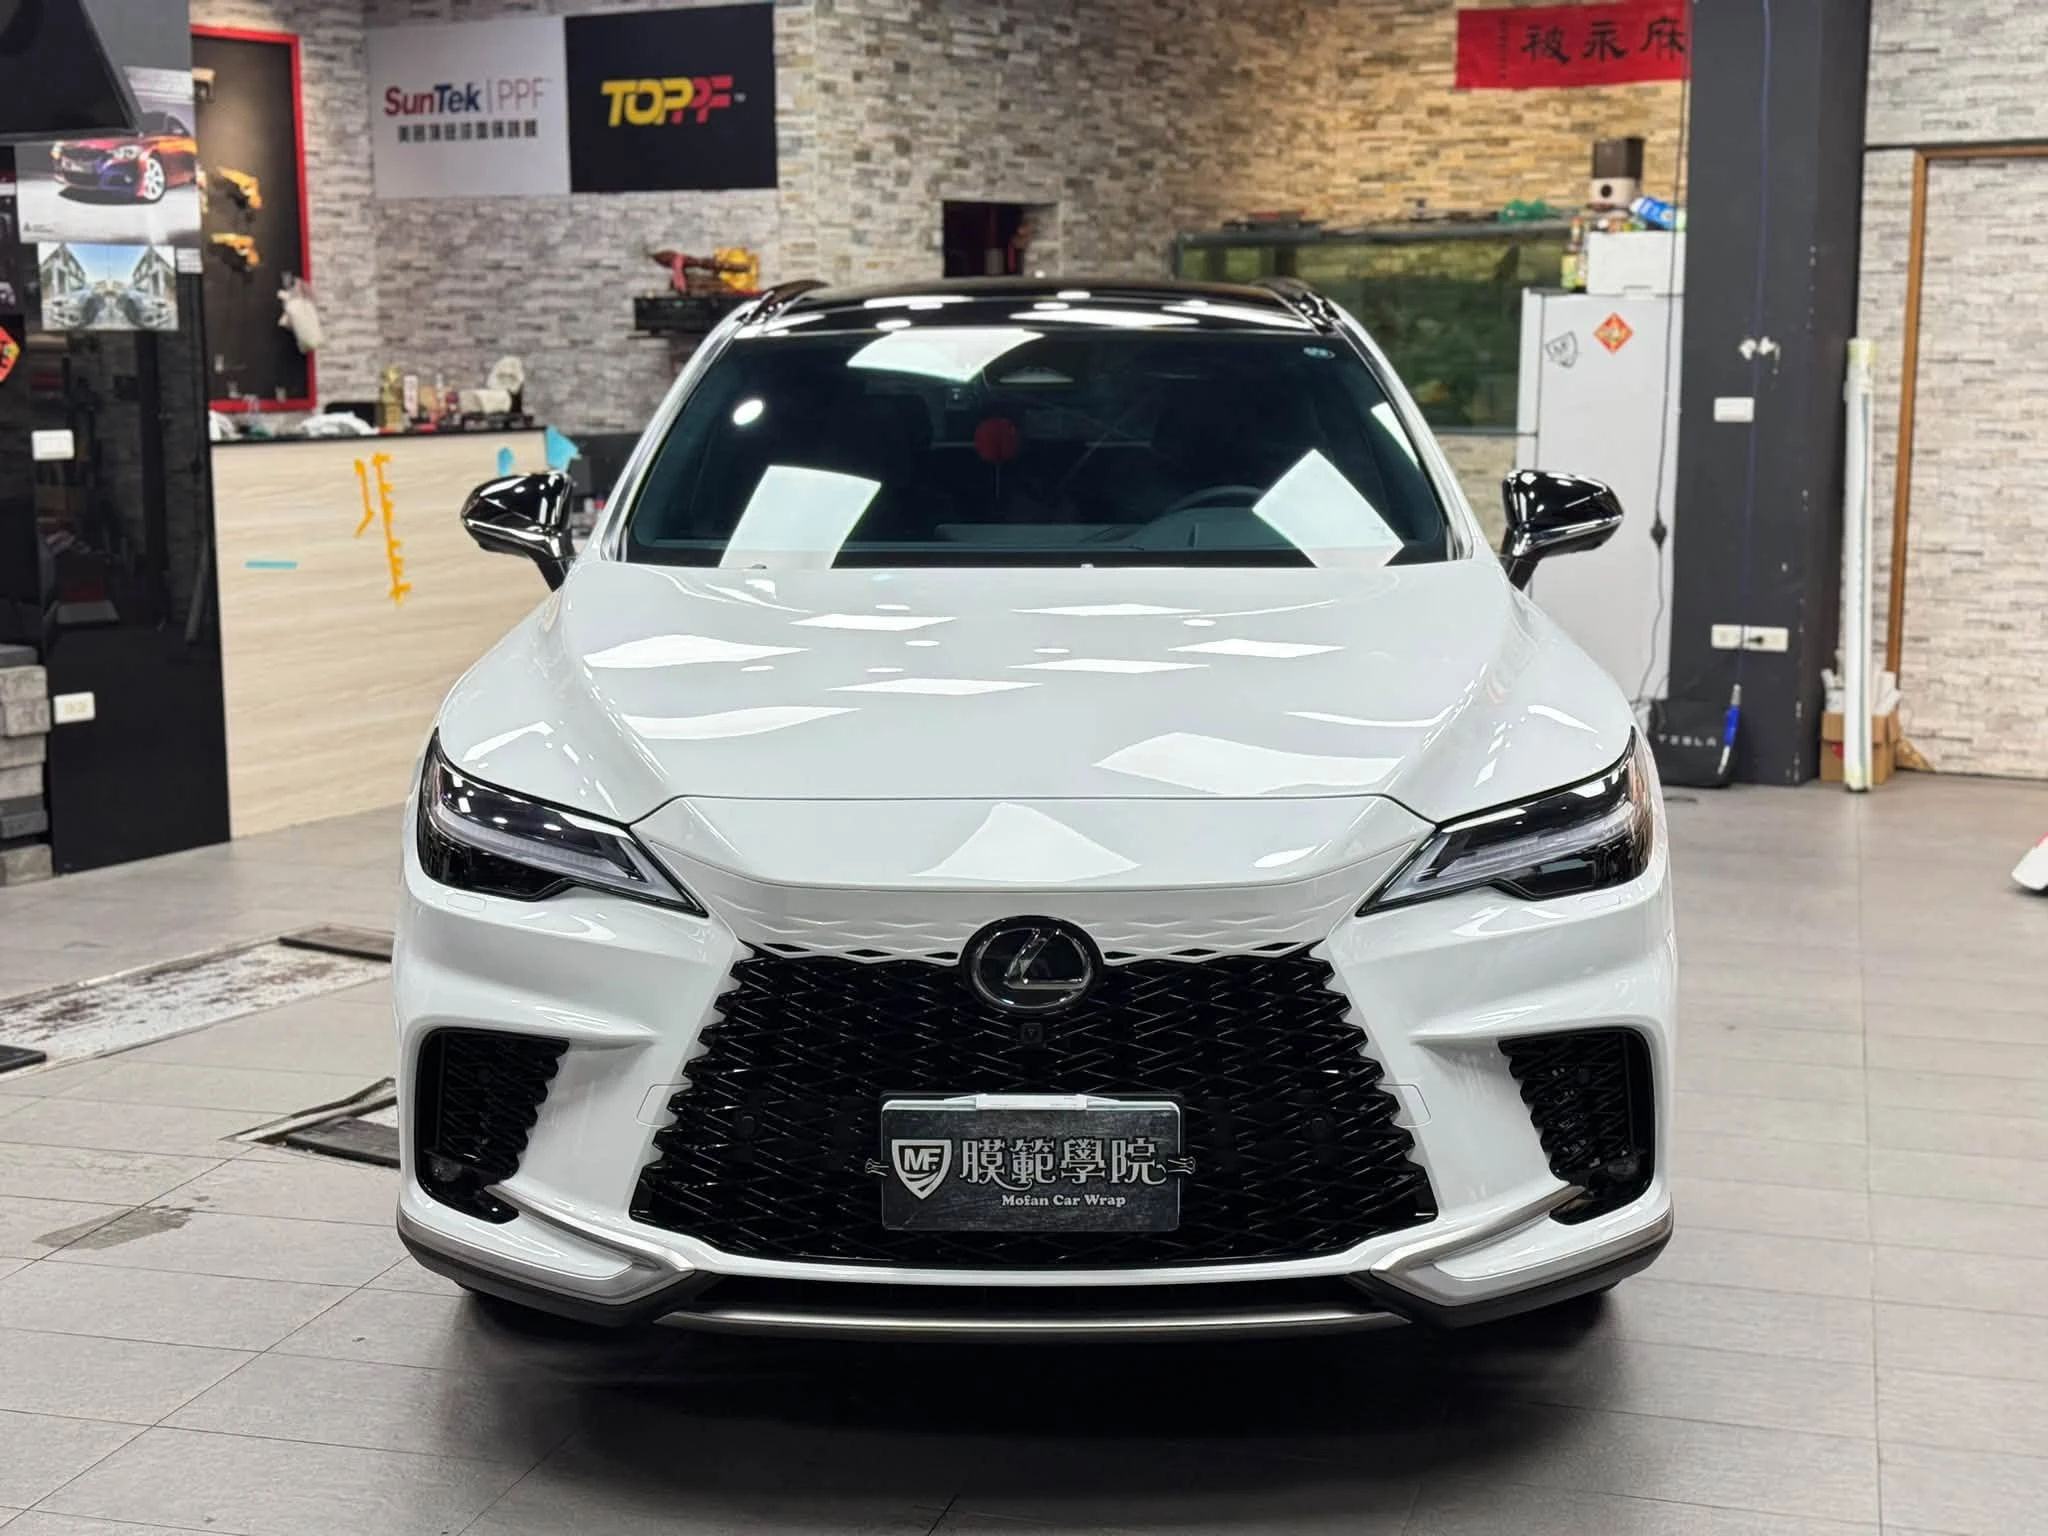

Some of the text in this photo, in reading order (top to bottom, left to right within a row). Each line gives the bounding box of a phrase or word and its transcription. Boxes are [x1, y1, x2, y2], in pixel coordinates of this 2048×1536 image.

[383, 78, 545, 117] SunTek PPF
[601, 75, 734, 127] TOPPF
[904, 1149, 941, 1171] MF
[959, 1137, 1168, 1192] 膜範學院
[1001, 1194, 1127, 1208] Mofan Car Wrap
